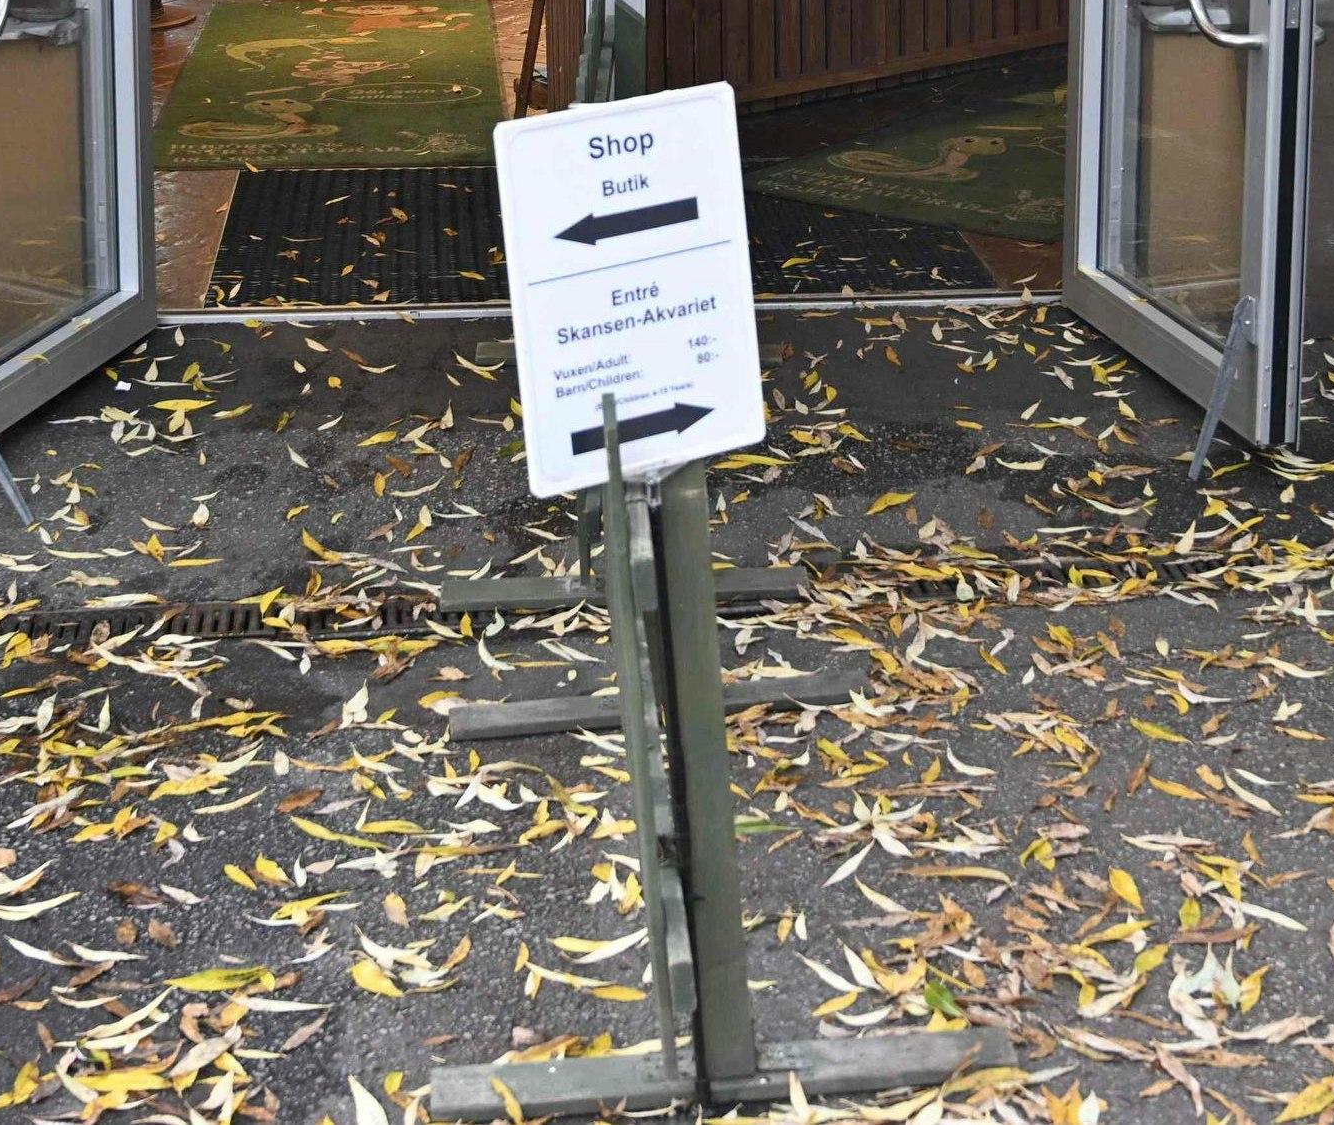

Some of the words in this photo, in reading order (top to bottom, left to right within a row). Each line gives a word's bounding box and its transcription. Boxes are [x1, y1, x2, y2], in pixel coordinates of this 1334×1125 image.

[588, 130, 654, 159] Shop
[602, 175, 650, 197] Butik
[611, 281, 659, 307] Entré
[557, 296, 717, 345] Skansen-Akvariet
[553, 354, 631, 380] Vuxen/Adult:
[555, 369, 644, 399] Barn/Children:
